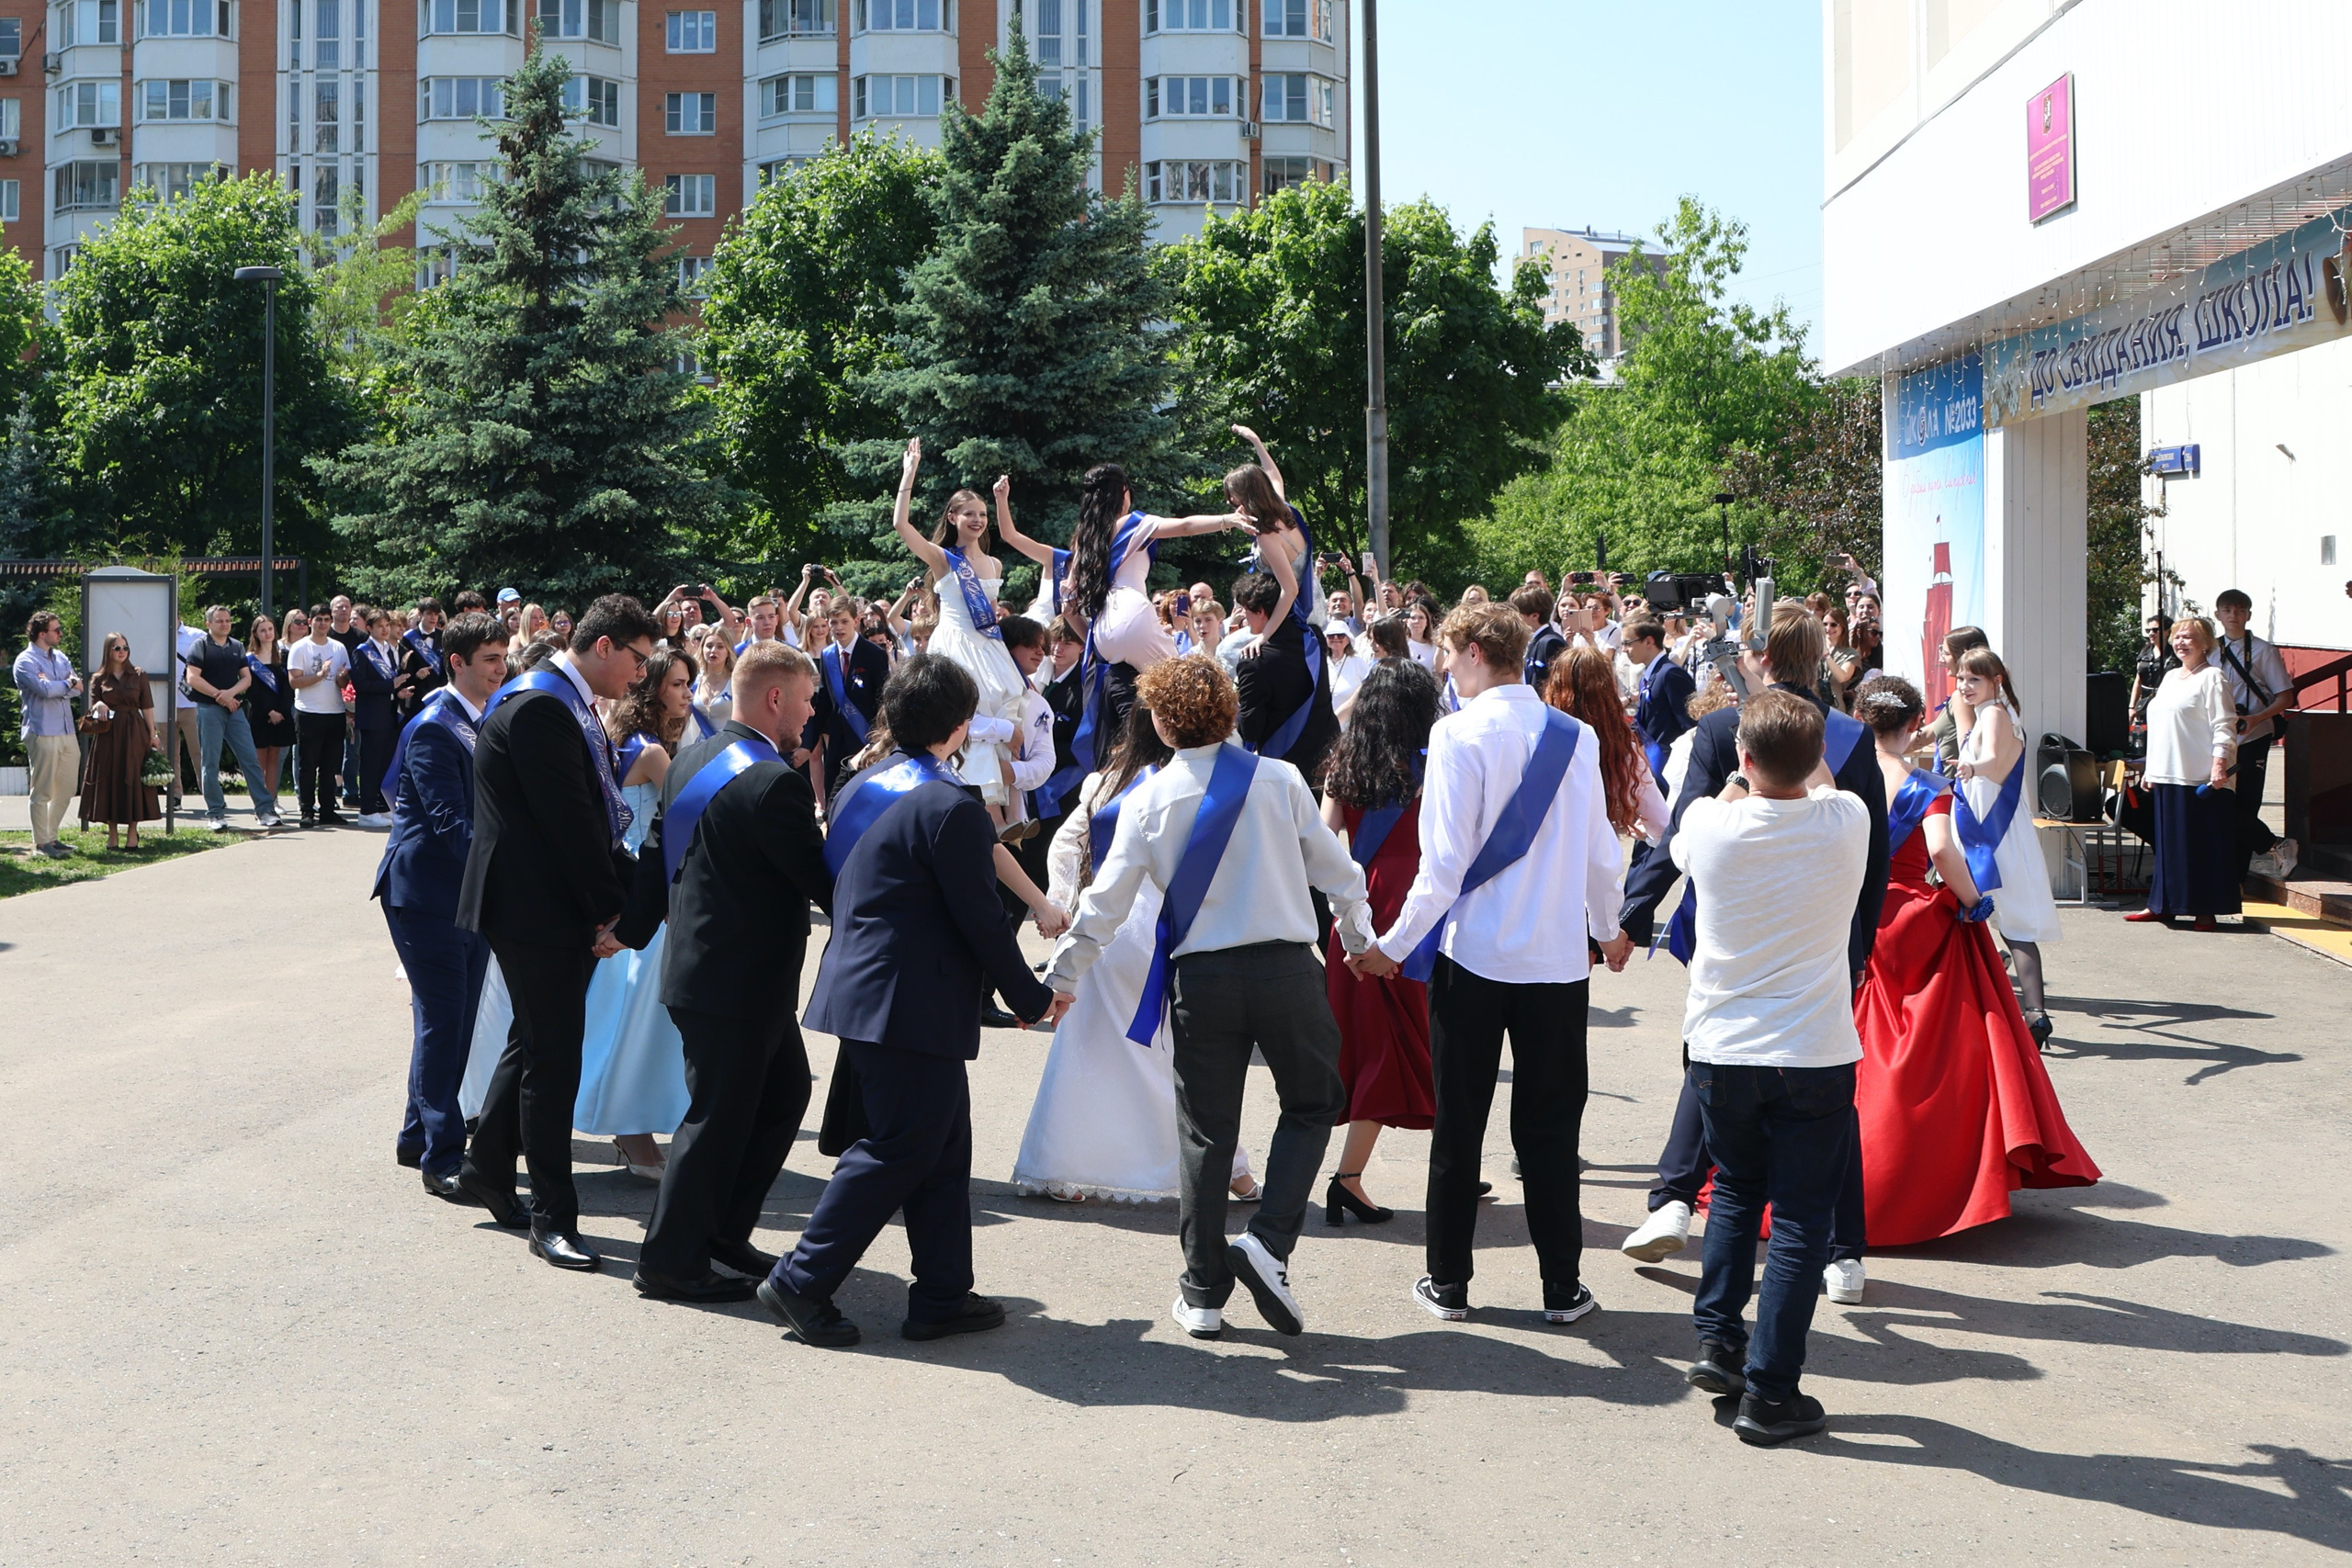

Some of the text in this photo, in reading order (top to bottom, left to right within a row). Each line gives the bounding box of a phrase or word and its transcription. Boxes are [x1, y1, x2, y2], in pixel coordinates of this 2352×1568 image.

[2030, 250, 2314, 412] ДО СВИДАНИЯ, ШКОЛА!
[616, 809, 632, 830] 202
